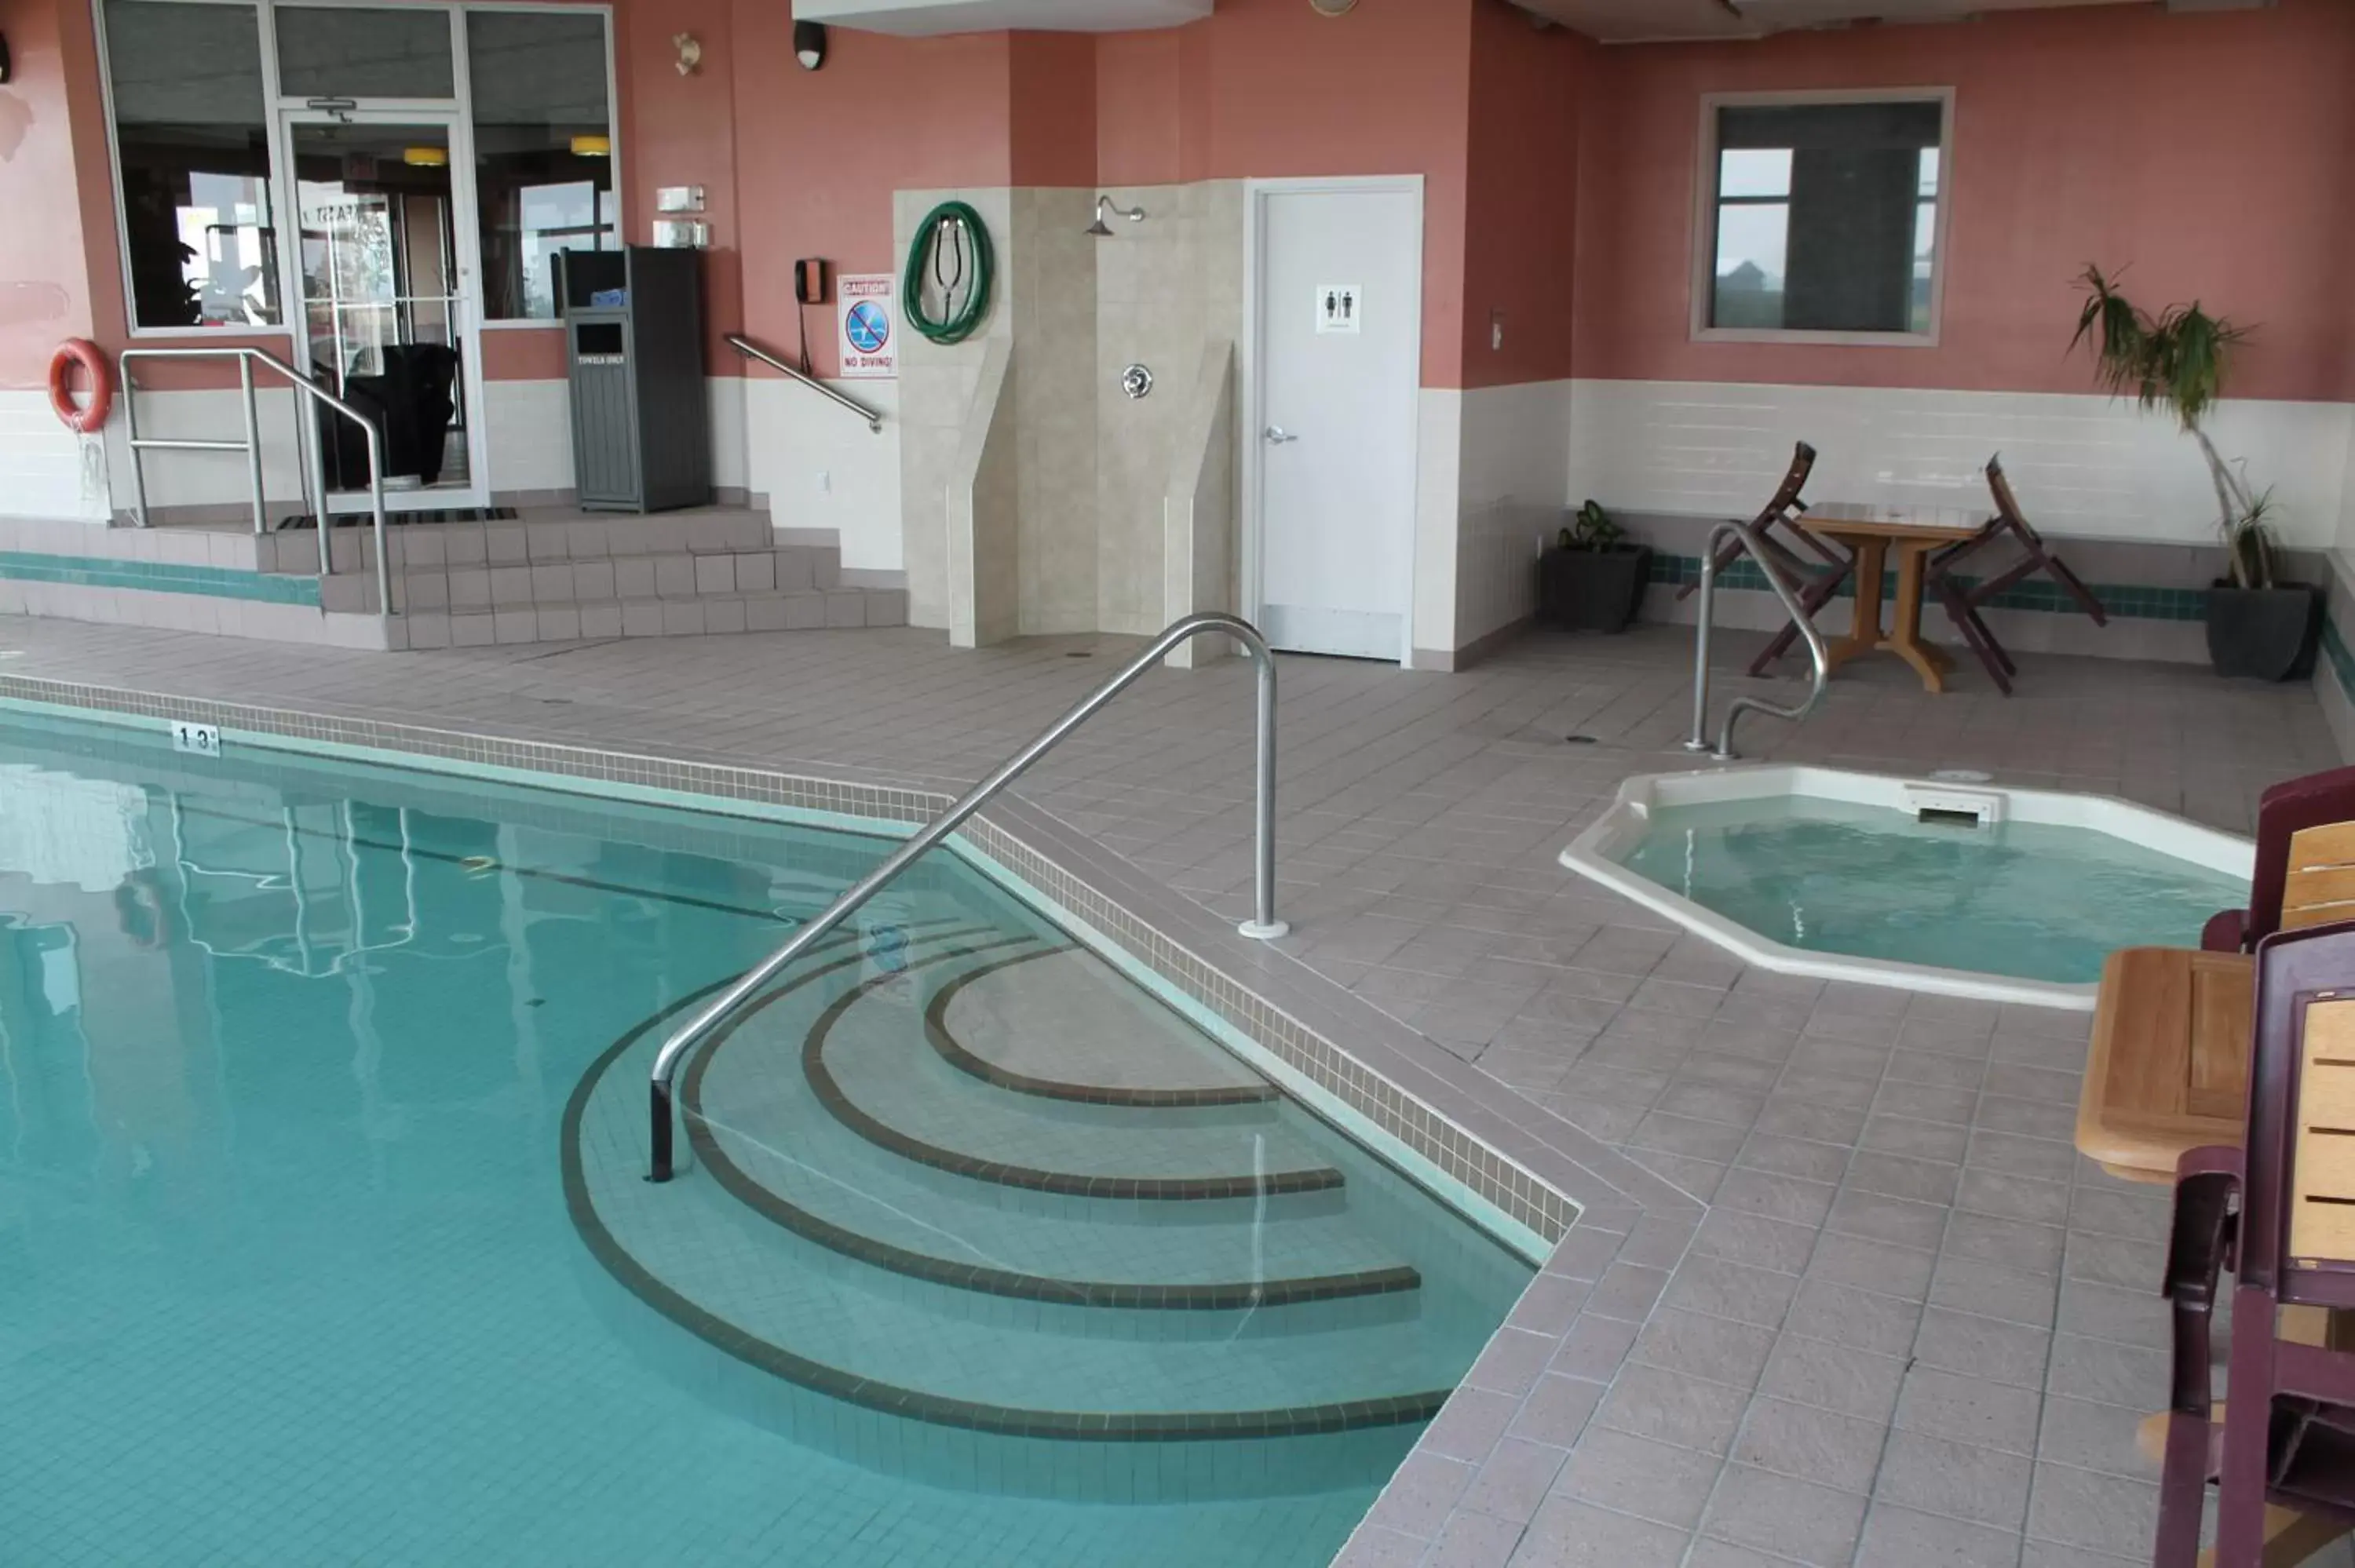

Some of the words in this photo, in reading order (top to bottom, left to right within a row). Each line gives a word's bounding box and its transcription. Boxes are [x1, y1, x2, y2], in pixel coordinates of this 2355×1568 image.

[578, 356, 604, 364] TOWELS
[605, 356, 624, 364] ONLY
[845, 356, 858, 367] NO
